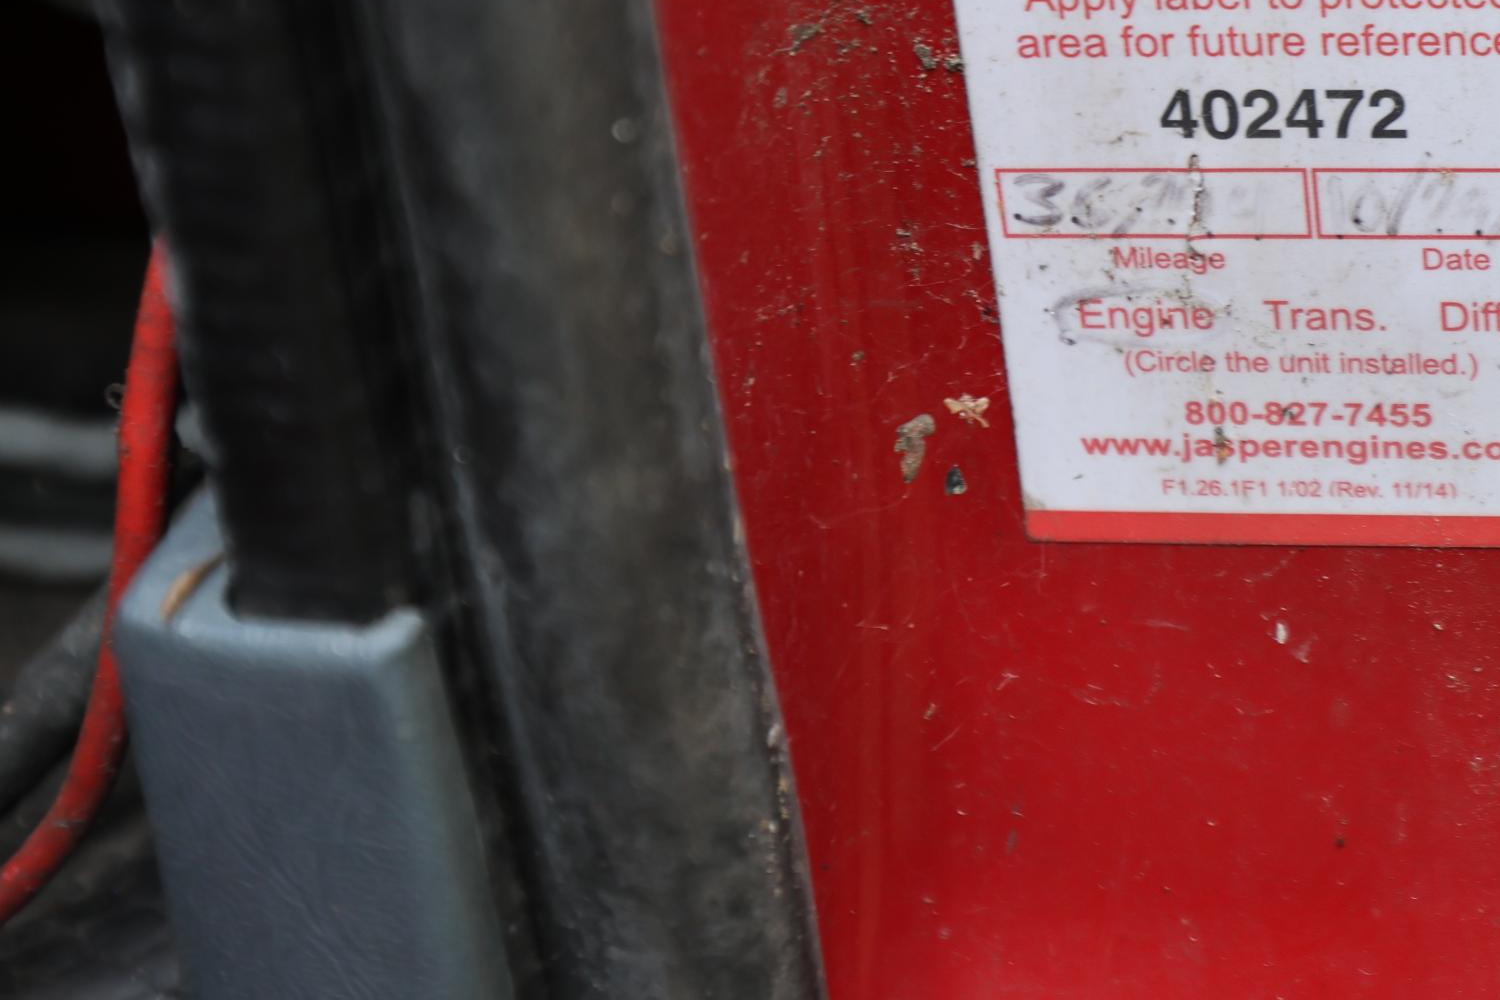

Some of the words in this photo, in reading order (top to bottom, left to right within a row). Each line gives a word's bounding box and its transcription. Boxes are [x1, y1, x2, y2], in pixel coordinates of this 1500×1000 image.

[1018, 34, 1108, 59] area
[1121, 25, 1175, 58] for
[1188, 25, 1306, 57] future
[1160, 89, 1407, 140] 402472
[1113, 246, 1226, 275] Mileage
[1423, 247, 1492, 272] Date
[1078, 297, 1214, 338] Engine
[1263, 299, 1386, 332] Trans.
[1124, 349, 1216, 378] (Circle
[1225, 352, 1270, 372] the
[1280, 353, 1332, 374] unit
[1339, 353, 1479, 380] installed.)
[1184, 401, 1432, 428] 800-827-7455
[1162, 478, 1268, 497] F1.26.1F1
[1328, 480, 1384, 499] (Rev.
[1392, 481, 1458, 499] 11/14)
